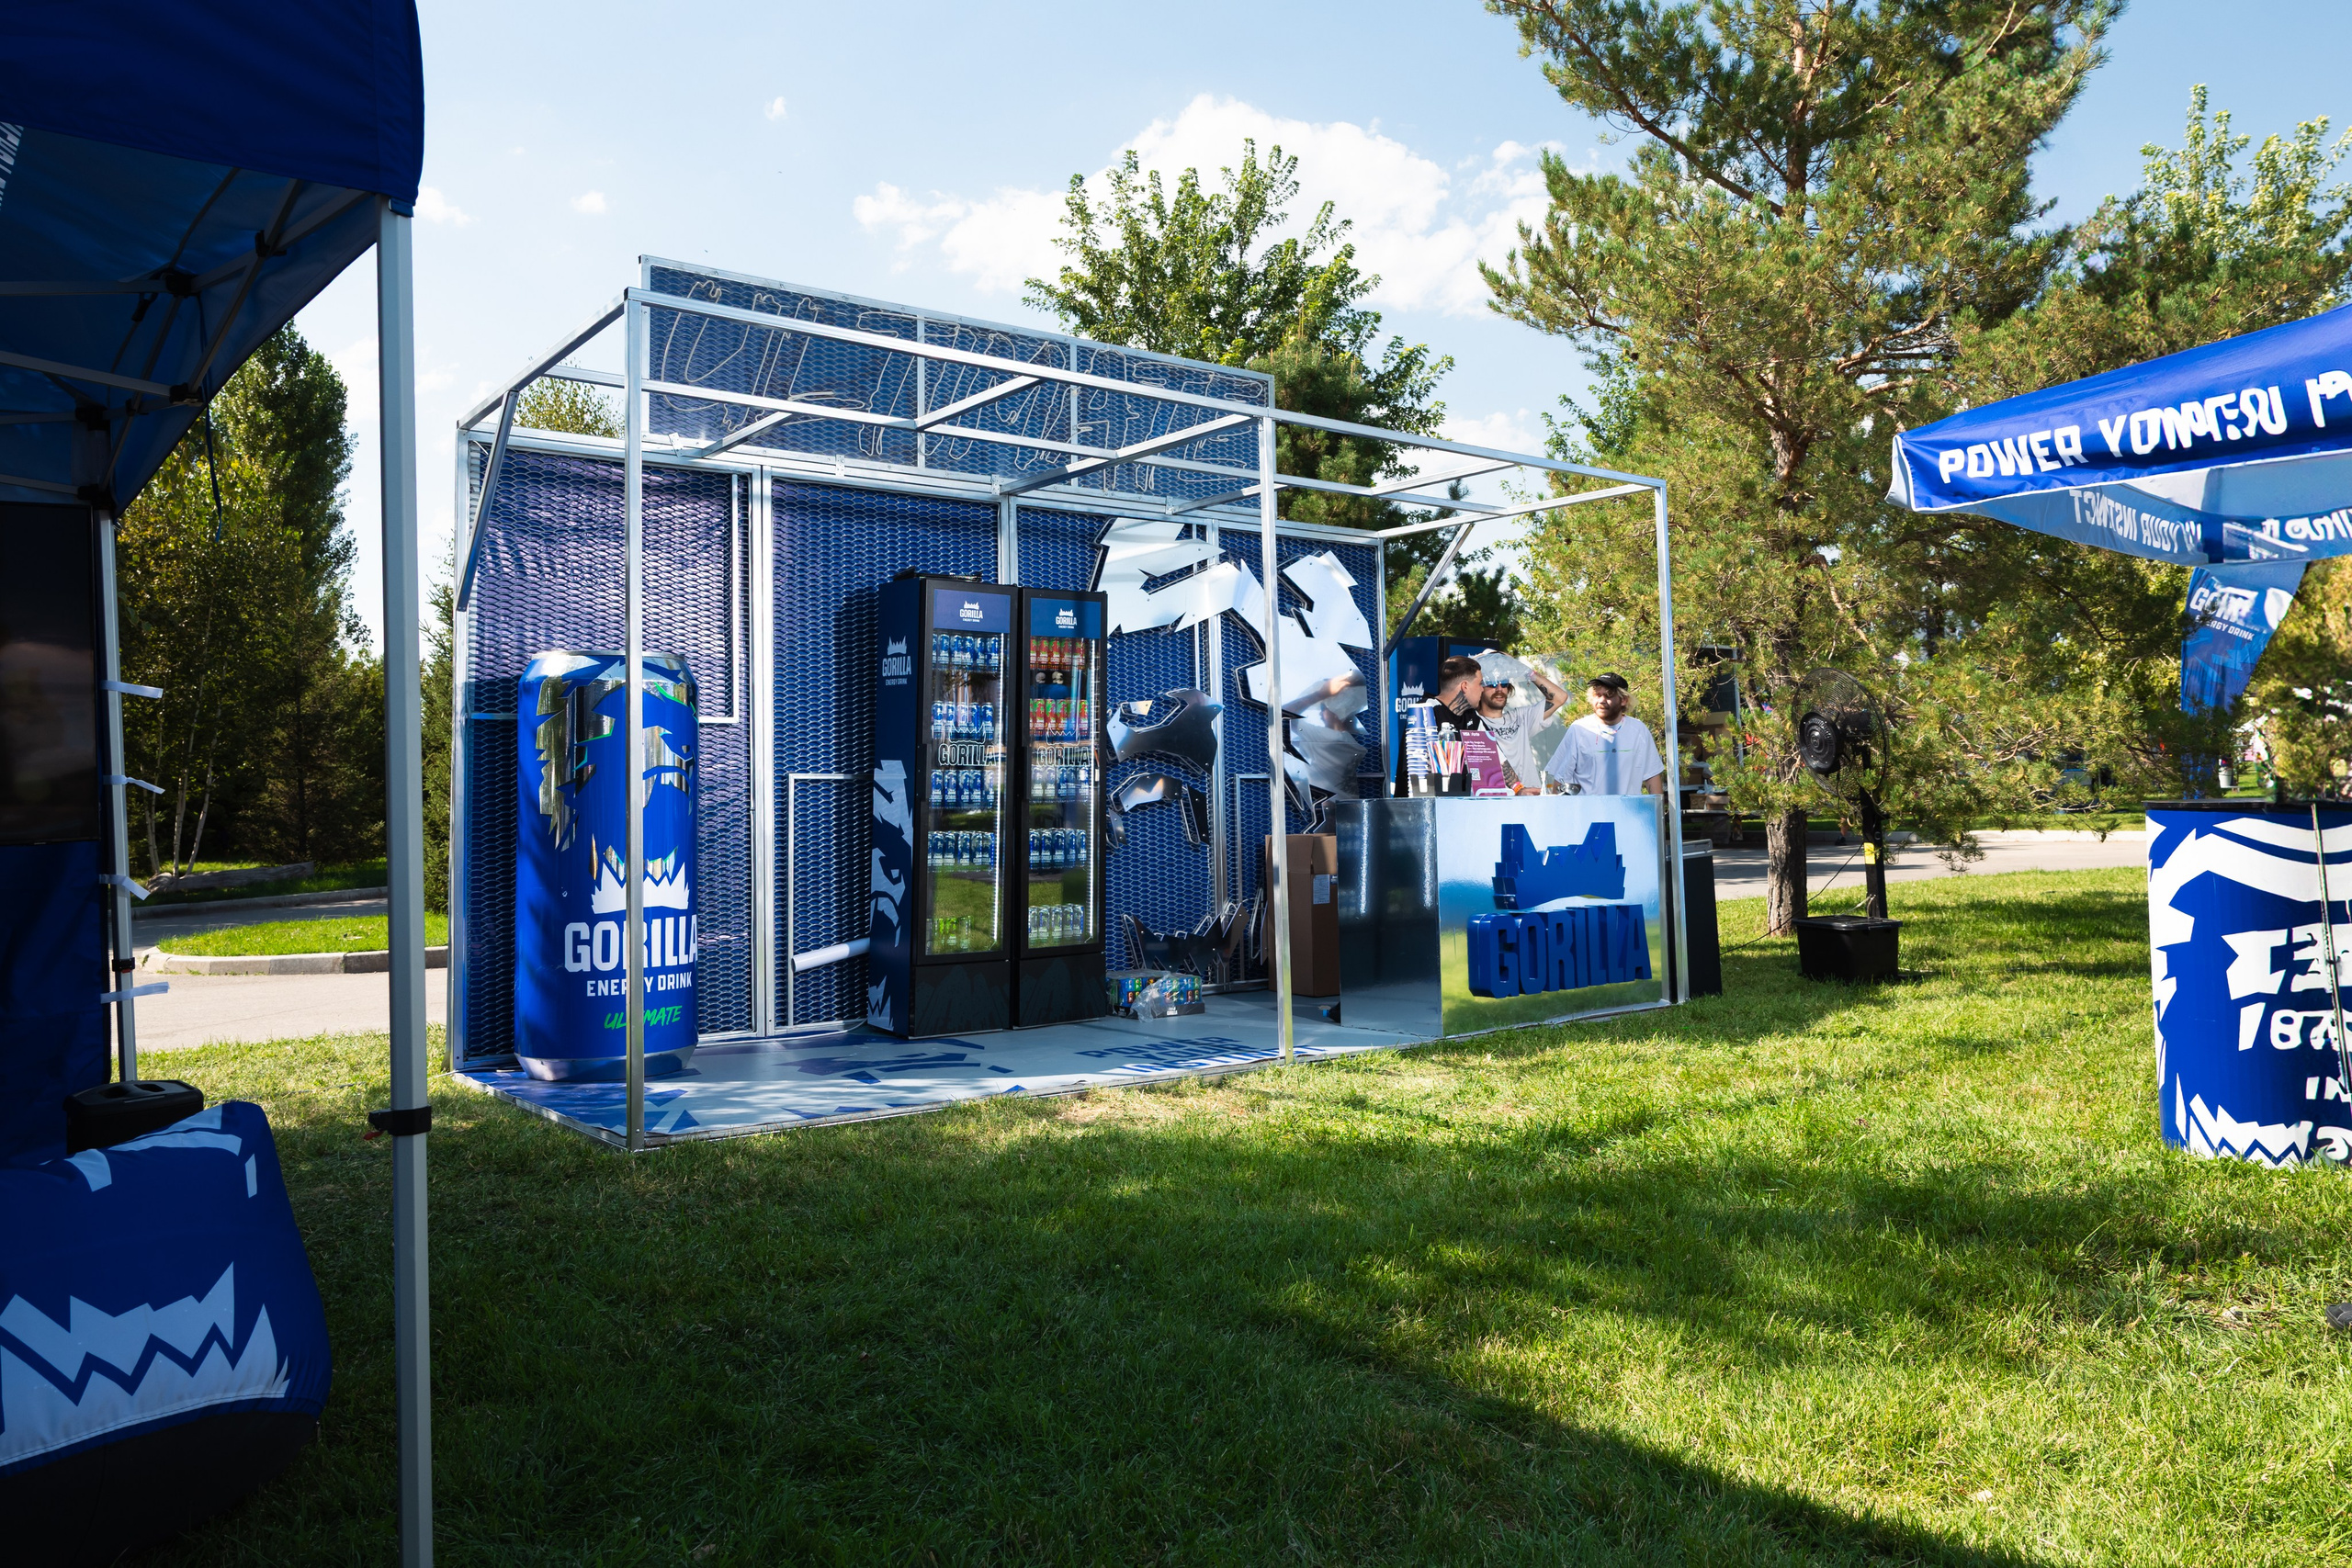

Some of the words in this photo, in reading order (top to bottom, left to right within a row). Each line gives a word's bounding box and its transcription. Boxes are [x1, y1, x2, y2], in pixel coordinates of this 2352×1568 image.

[1939, 424, 2089, 484] POWER
[959, 608, 983, 619] GORILLA
[1055, 615, 1078, 626] GORILLA
[2195, 615, 2228, 632] ERGY
[2228, 626, 2255, 641] DRINK
[882, 656, 911, 677] GORILLA
[938, 743, 997, 767] GORILLA
[1036, 745, 1091, 767] GORILLA
[1467, 903, 1653, 998] GORILLA
[586, 976, 654, 997] ENEY
[657, 971, 692, 991] DRINK
[604, 1005, 683, 1031] ULMATE
[1074, 1036, 1242, 1058] POWER
[1124, 1043, 1259, 1061] YOUR
